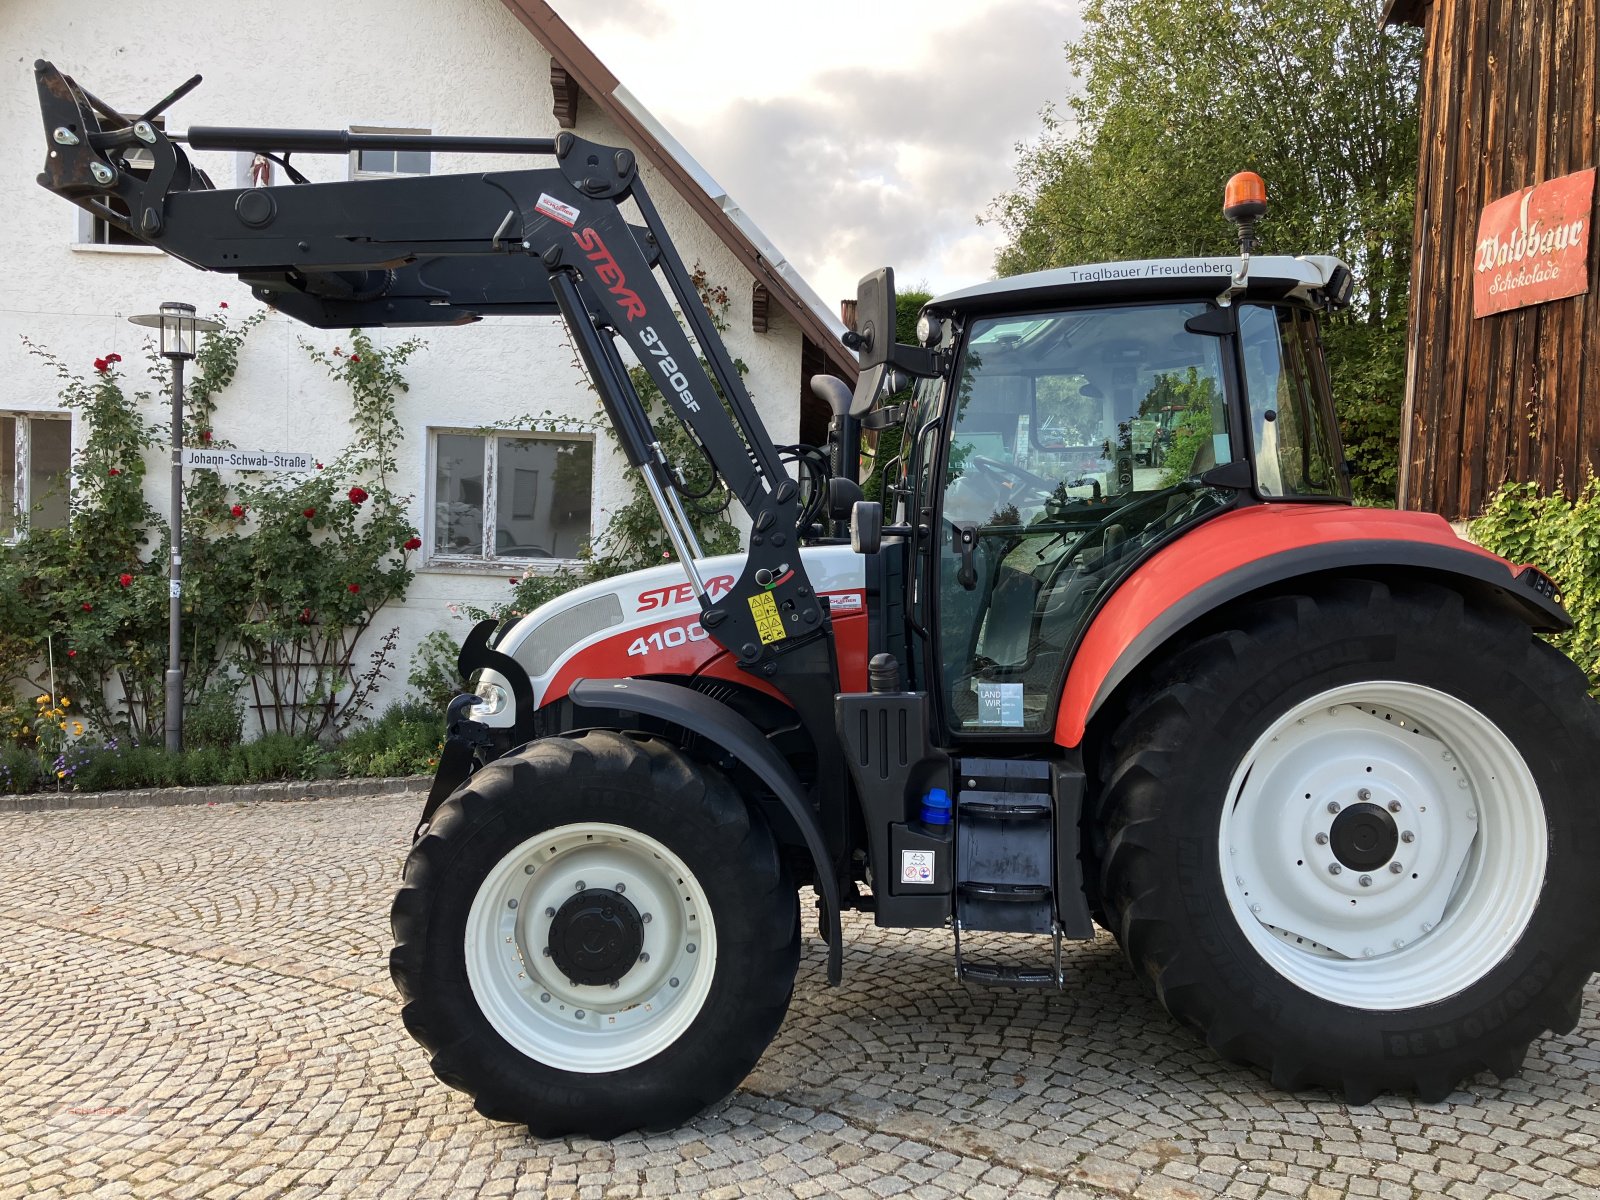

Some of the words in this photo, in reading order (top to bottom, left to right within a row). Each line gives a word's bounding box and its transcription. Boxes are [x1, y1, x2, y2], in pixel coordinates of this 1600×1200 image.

[572, 228, 647, 322] STEYR
[1070, 267, 1141, 282] Traglbauer
[1145, 262, 1233, 276] /Freudenberg
[1489, 261, 1560, 295] Schokolade
[639, 326, 701, 413] 3720SF
[189, 453, 306, 467] Johann-Schwab-Straße
